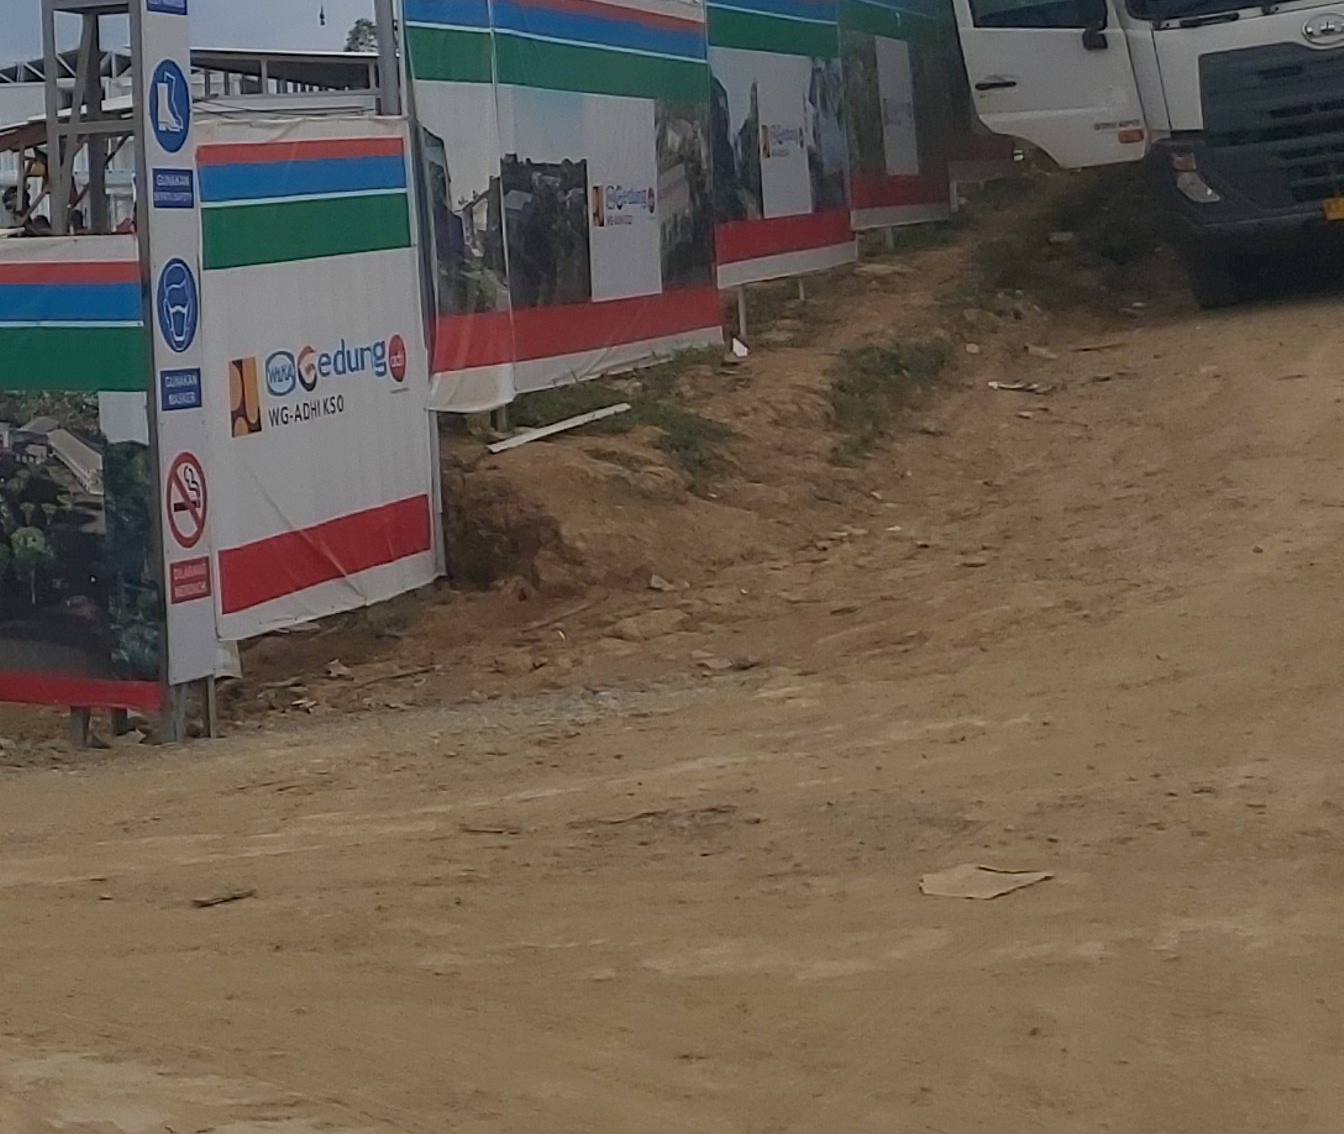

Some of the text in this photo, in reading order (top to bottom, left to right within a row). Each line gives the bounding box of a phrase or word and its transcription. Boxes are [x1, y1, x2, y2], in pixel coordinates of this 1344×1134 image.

[297, 338, 388, 393] Gedung
[268, 394, 345, 428] WG-ADHI KSO
